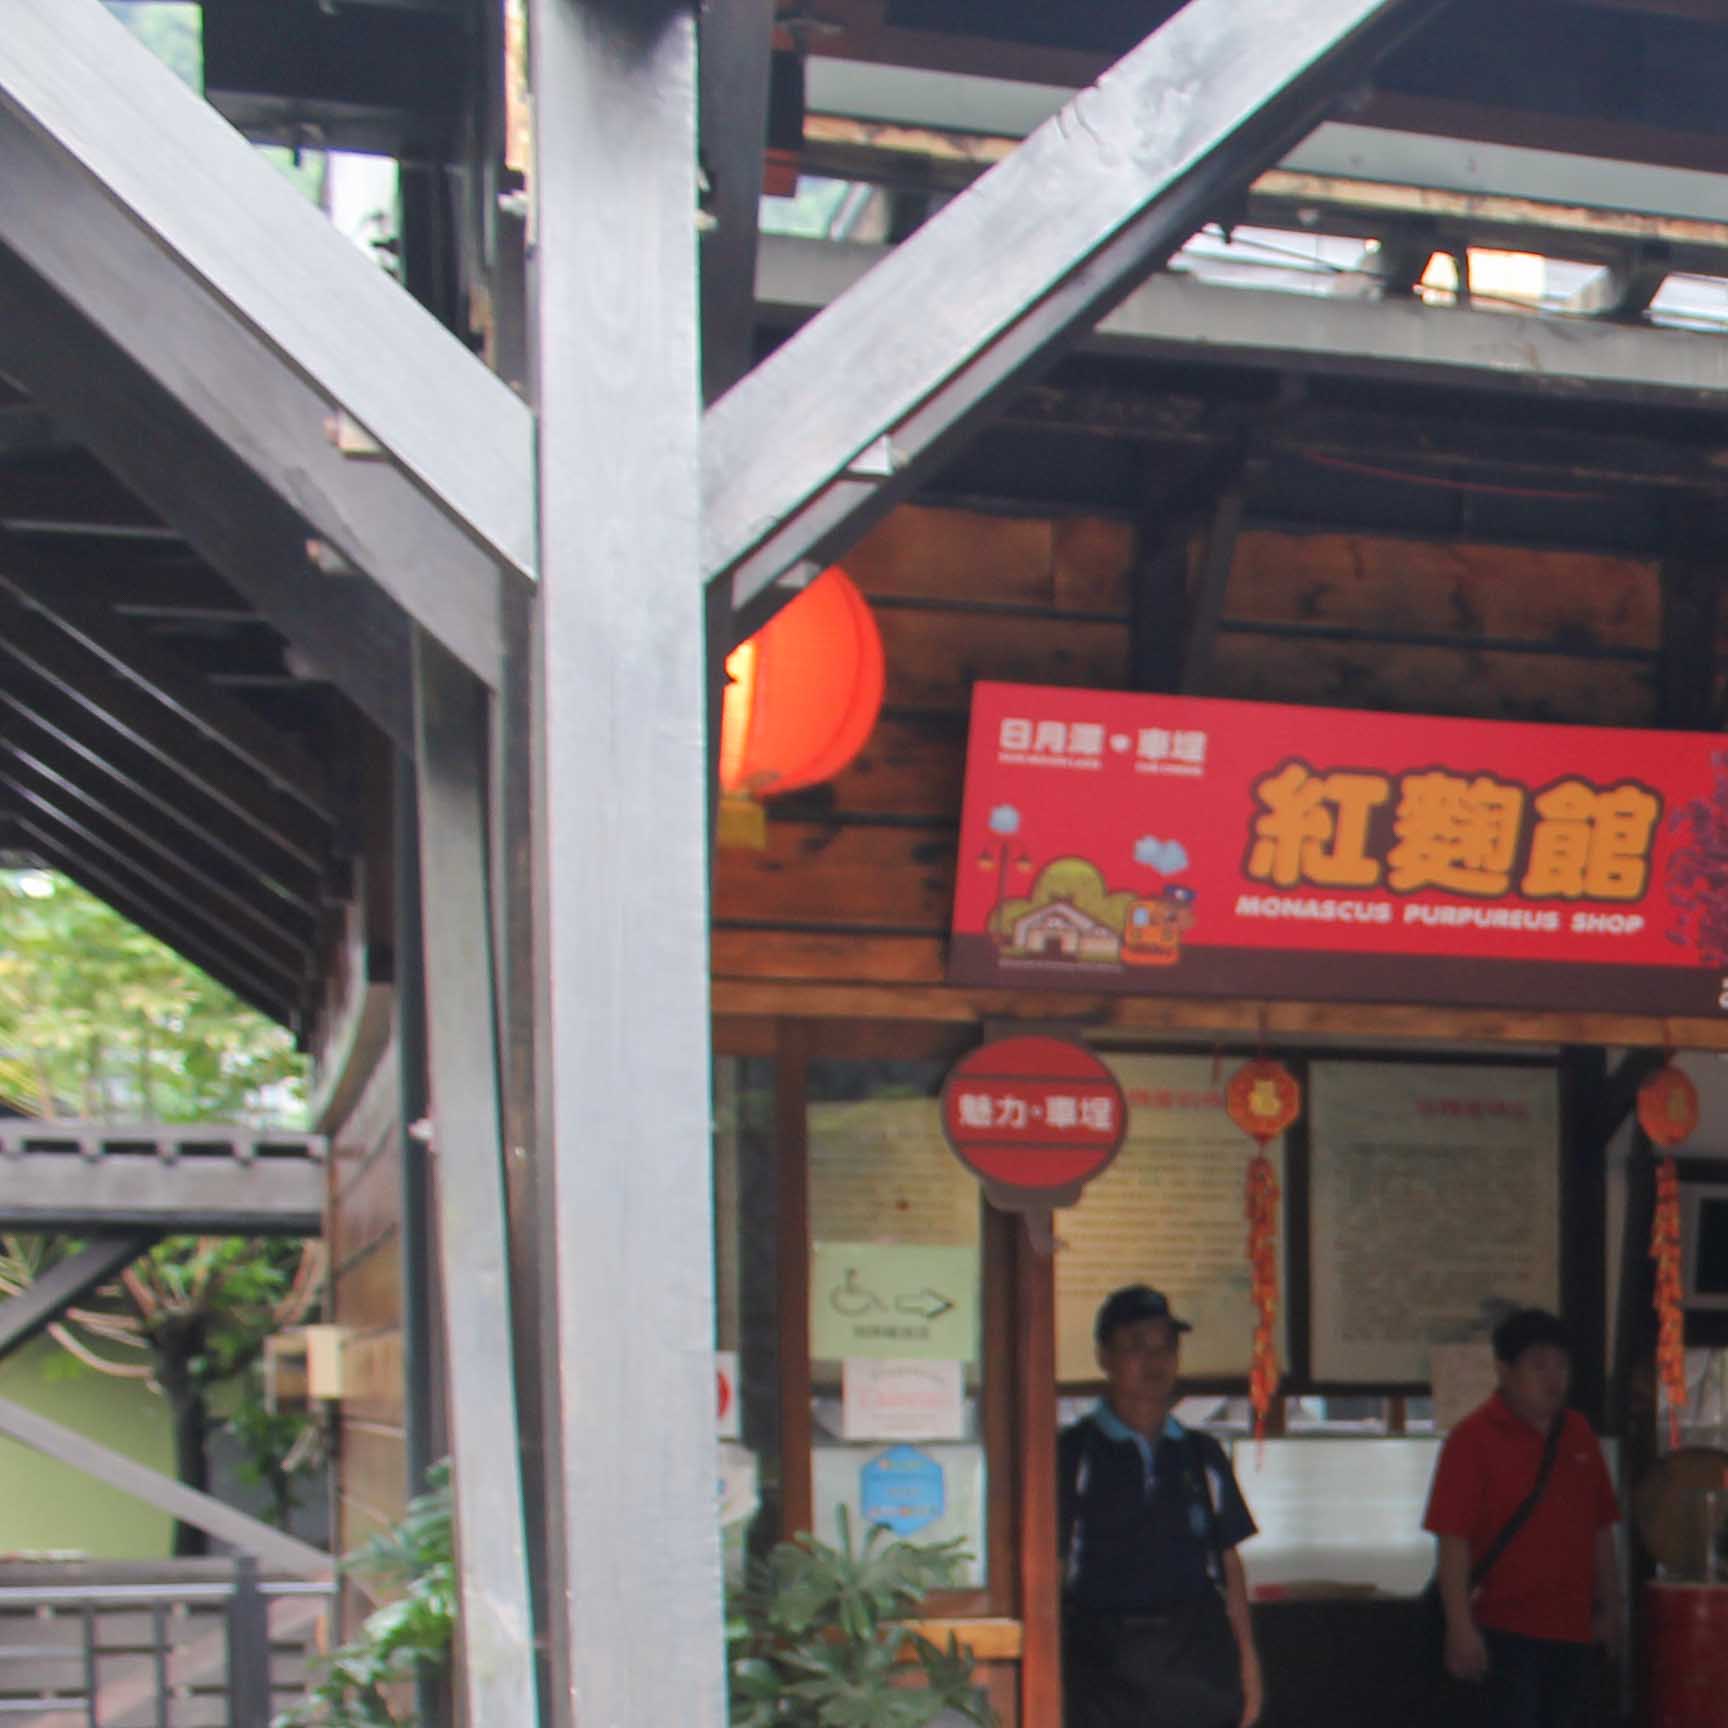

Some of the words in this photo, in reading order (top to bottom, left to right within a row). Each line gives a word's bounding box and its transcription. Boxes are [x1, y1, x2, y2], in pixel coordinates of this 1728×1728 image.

[1236, 896, 1391, 922] MONASCUS
[1404, 908, 1560, 931] PURPUREUS
[1571, 911, 1645, 934] SHOP
